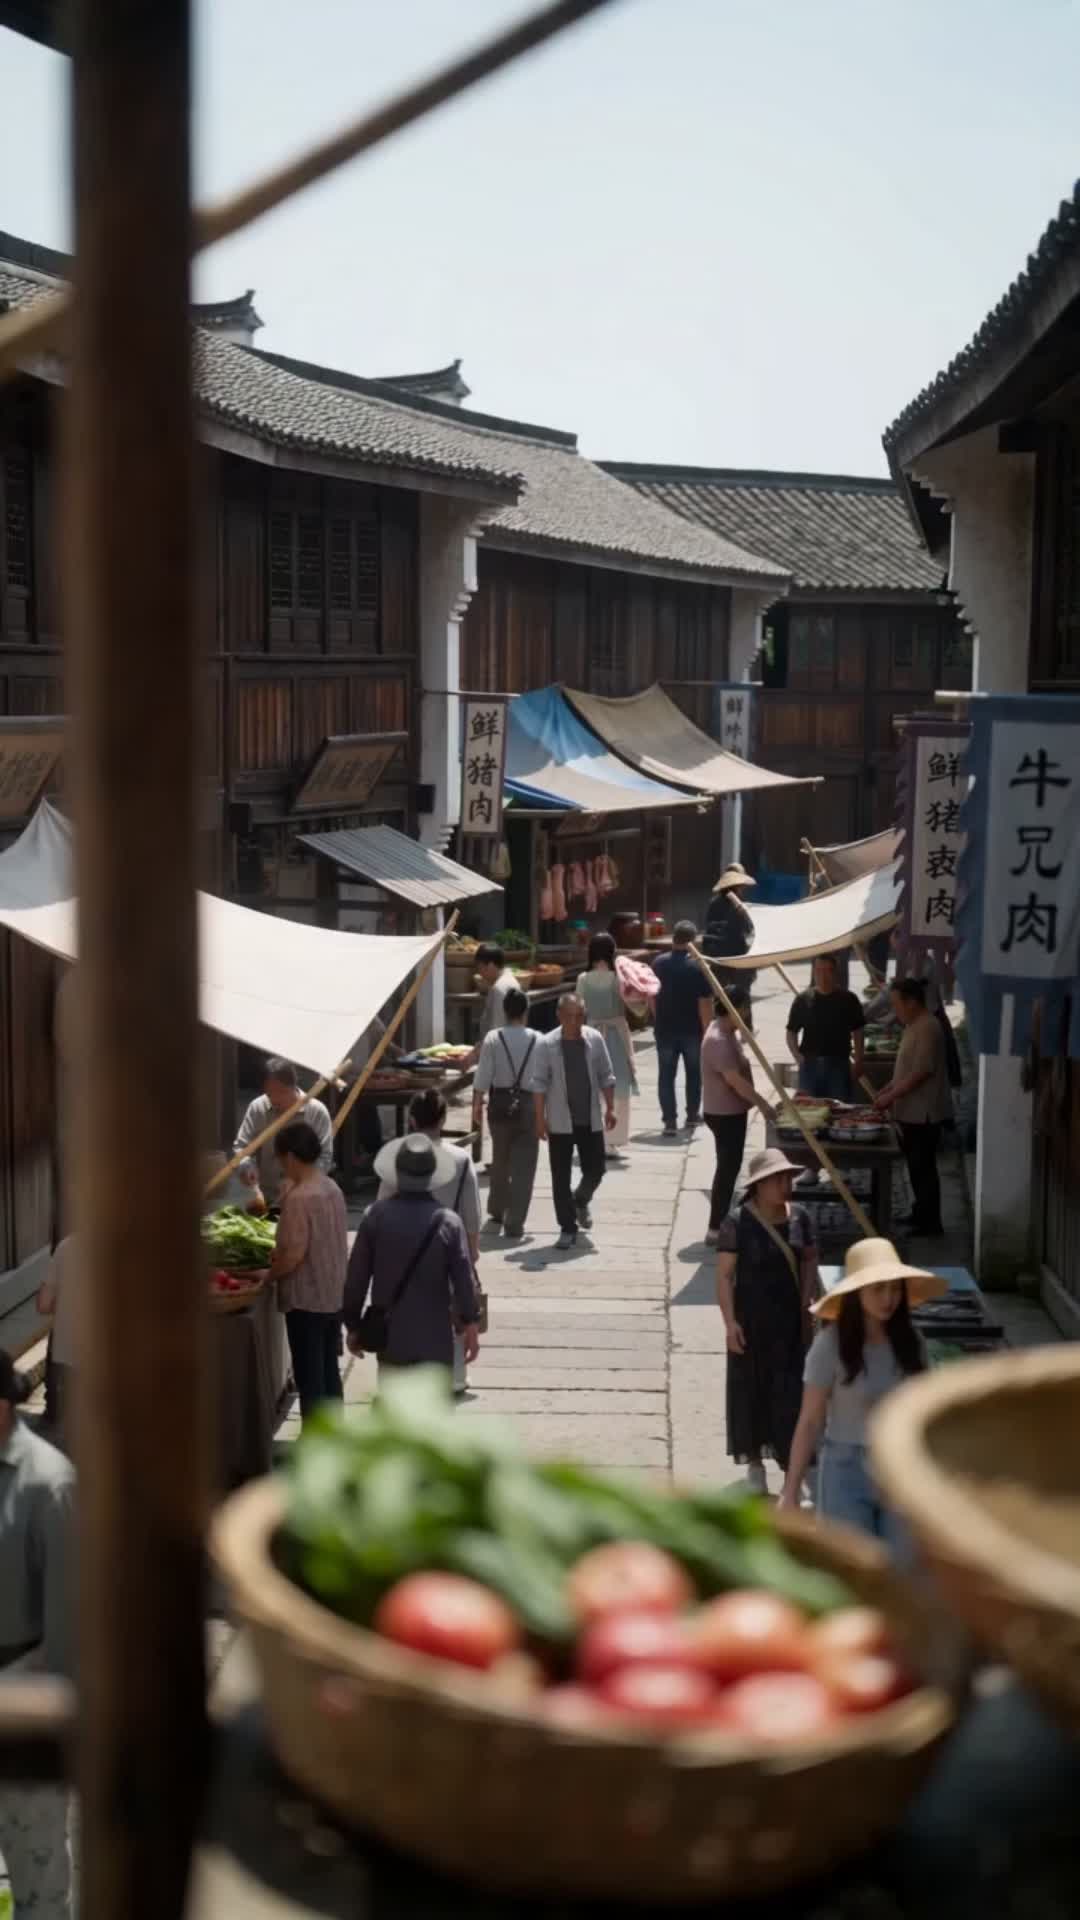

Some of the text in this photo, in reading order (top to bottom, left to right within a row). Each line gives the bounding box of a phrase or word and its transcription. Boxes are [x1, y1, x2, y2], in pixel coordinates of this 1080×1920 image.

[467, 709, 500, 825] 鲜猪肉
[1000, 748, 1072, 954] 牛兄肉
